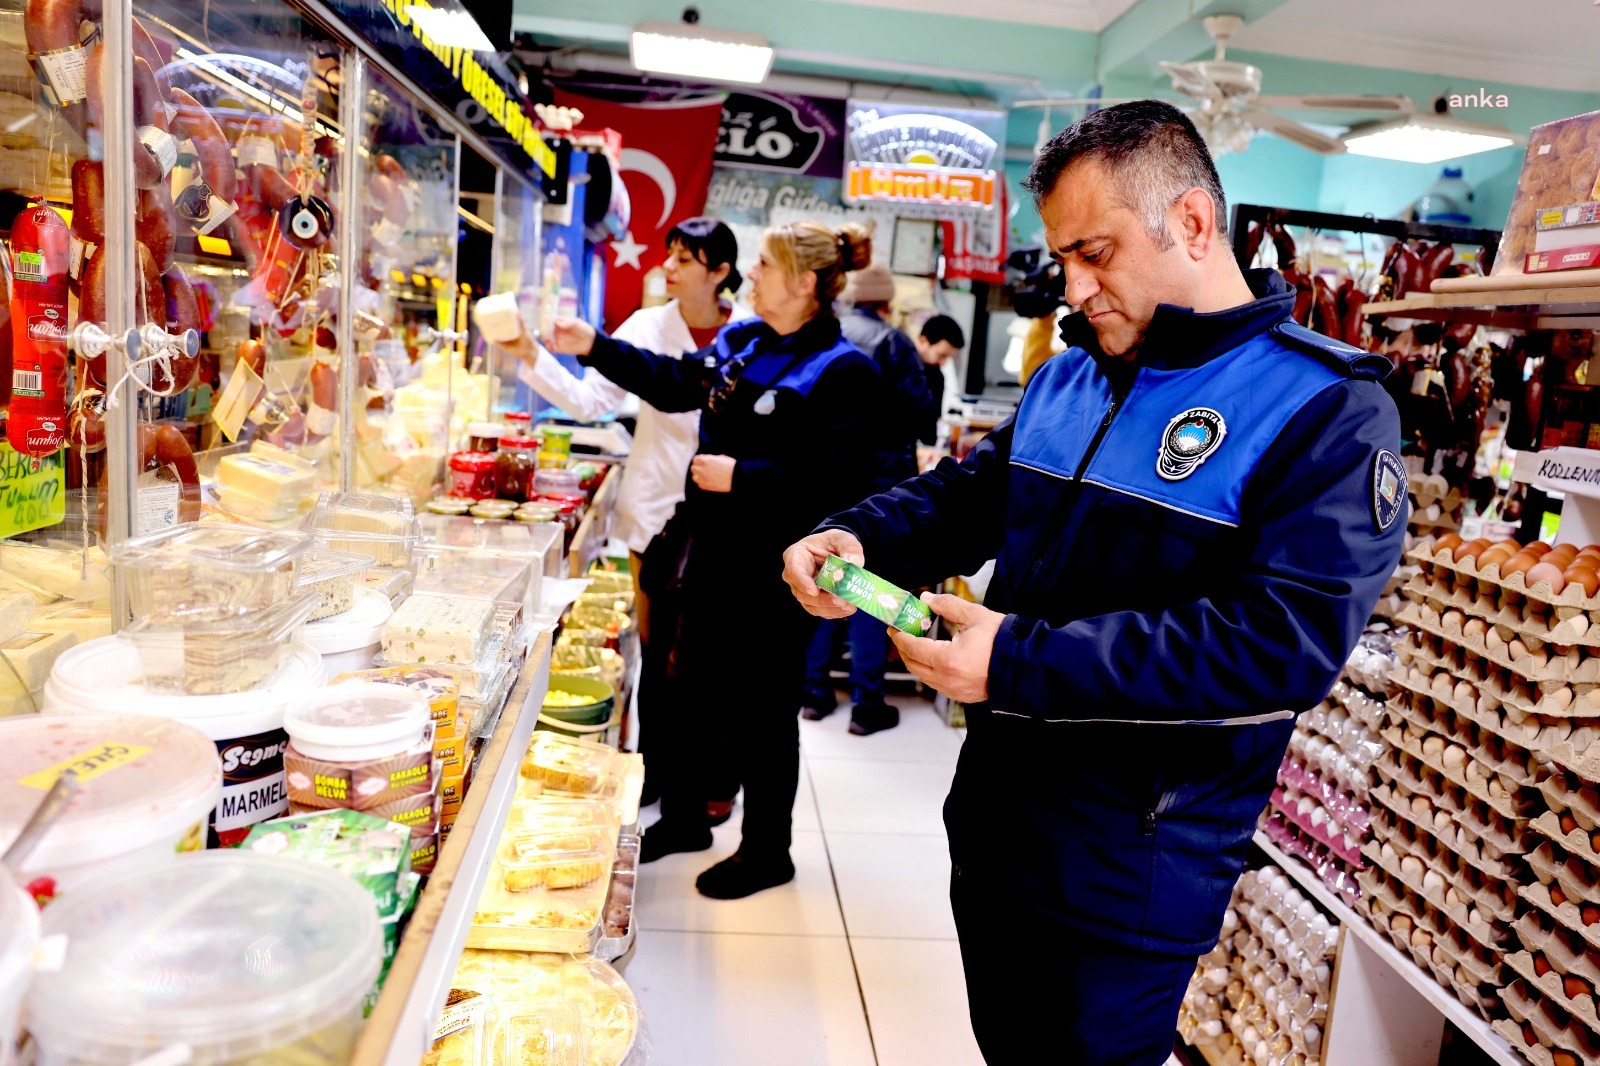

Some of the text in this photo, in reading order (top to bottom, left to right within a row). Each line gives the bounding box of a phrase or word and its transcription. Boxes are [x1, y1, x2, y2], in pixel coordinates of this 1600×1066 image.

[1189, 410, 1219, 425] ZABITA
[846, 581, 874, 601] BOMBA
[852, 573, 876, 592] HELVA
[222, 740, 287, 773] Segme
[314, 774, 348, 790] BOMBA
[389, 763, 429, 783] KAKAOLU
[222, 780, 288, 818] MARMEL
[315, 785, 347, 800] HELVA
[391, 805, 431, 823] KAKAOLU
[411, 845, 436, 860] KAOLU
